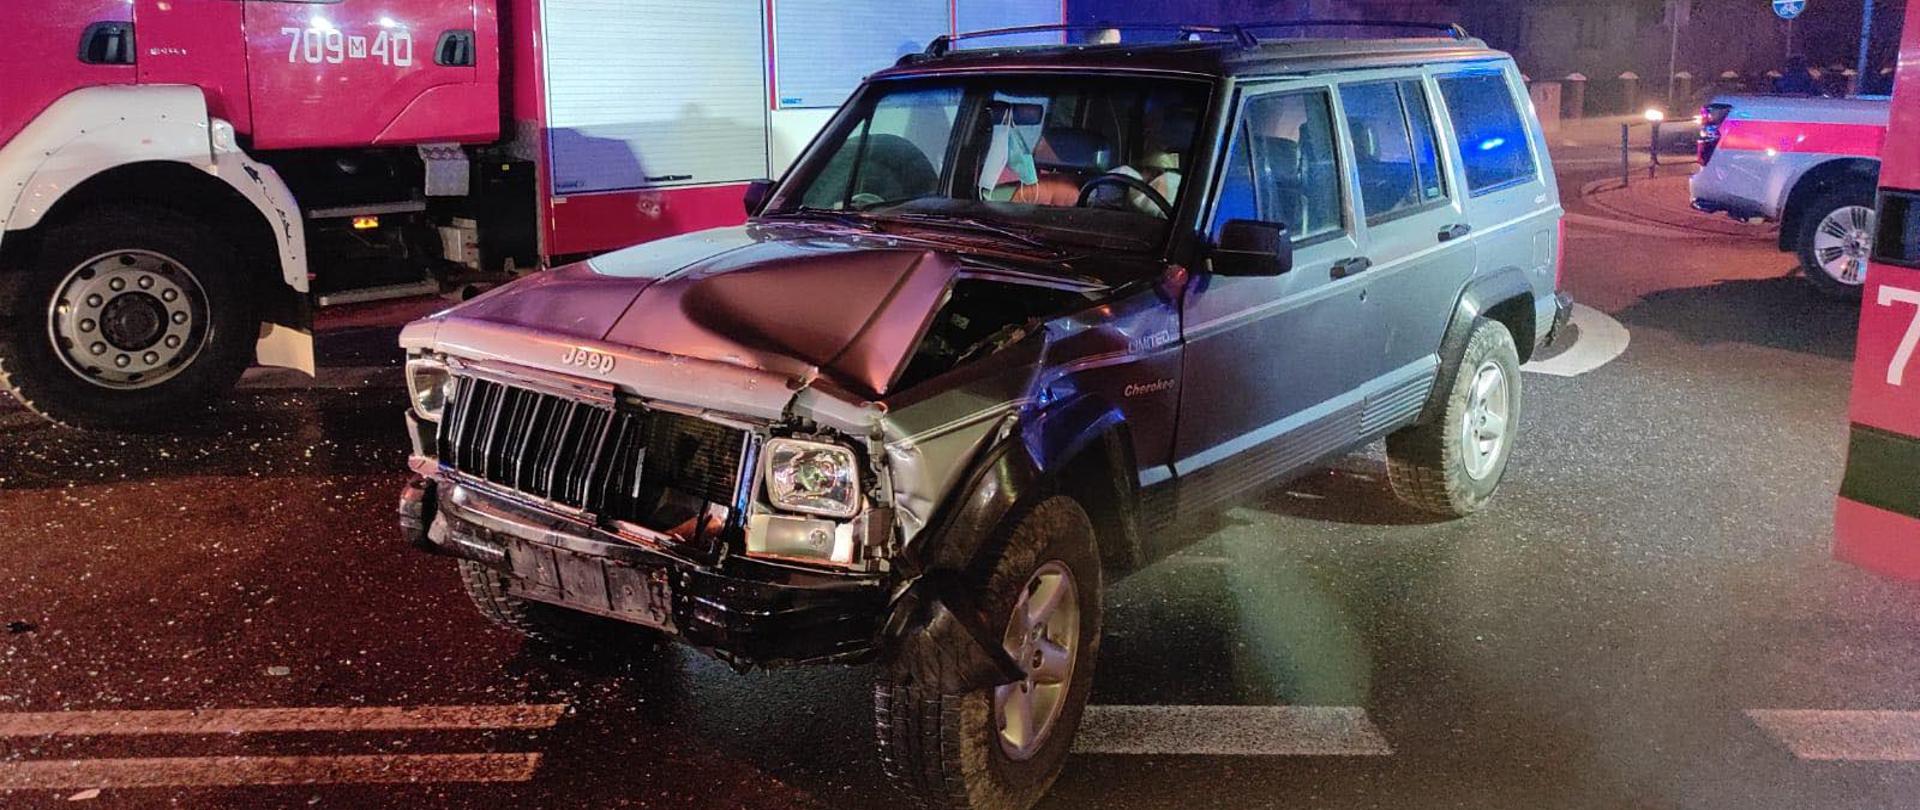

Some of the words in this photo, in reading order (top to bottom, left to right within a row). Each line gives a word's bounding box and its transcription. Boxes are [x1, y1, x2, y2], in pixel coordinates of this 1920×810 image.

[281, 27, 345, 63] 709
[371, 30, 413, 66] 40
[1128, 330, 1170, 353] LIMITED
[1878, 284, 1920, 386] 7
[562, 346, 615, 375] Jeep
[1124, 379, 1175, 397] Cherokee
